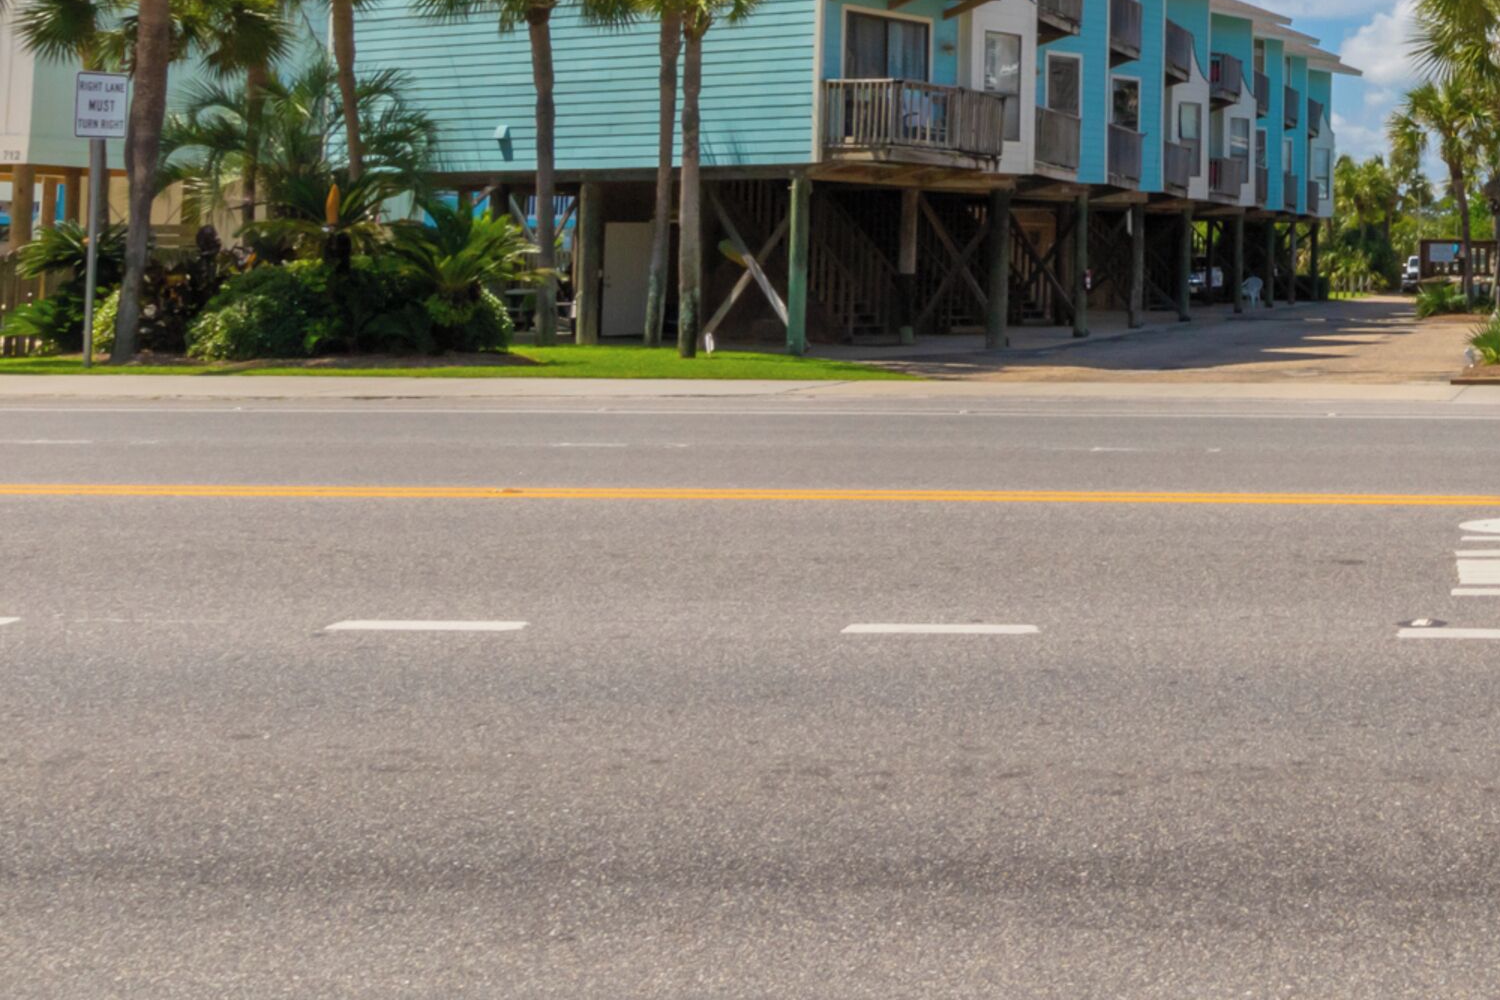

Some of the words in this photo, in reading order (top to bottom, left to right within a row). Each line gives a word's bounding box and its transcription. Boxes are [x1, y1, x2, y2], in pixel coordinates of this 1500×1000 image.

[79, 80, 103, 92] RIGHT
[105, 82, 125, 93] LANE
[88, 99, 115, 112] MUST
[78, 119, 99, 129] TURN
[101, 119, 124, 129] RIGHT
